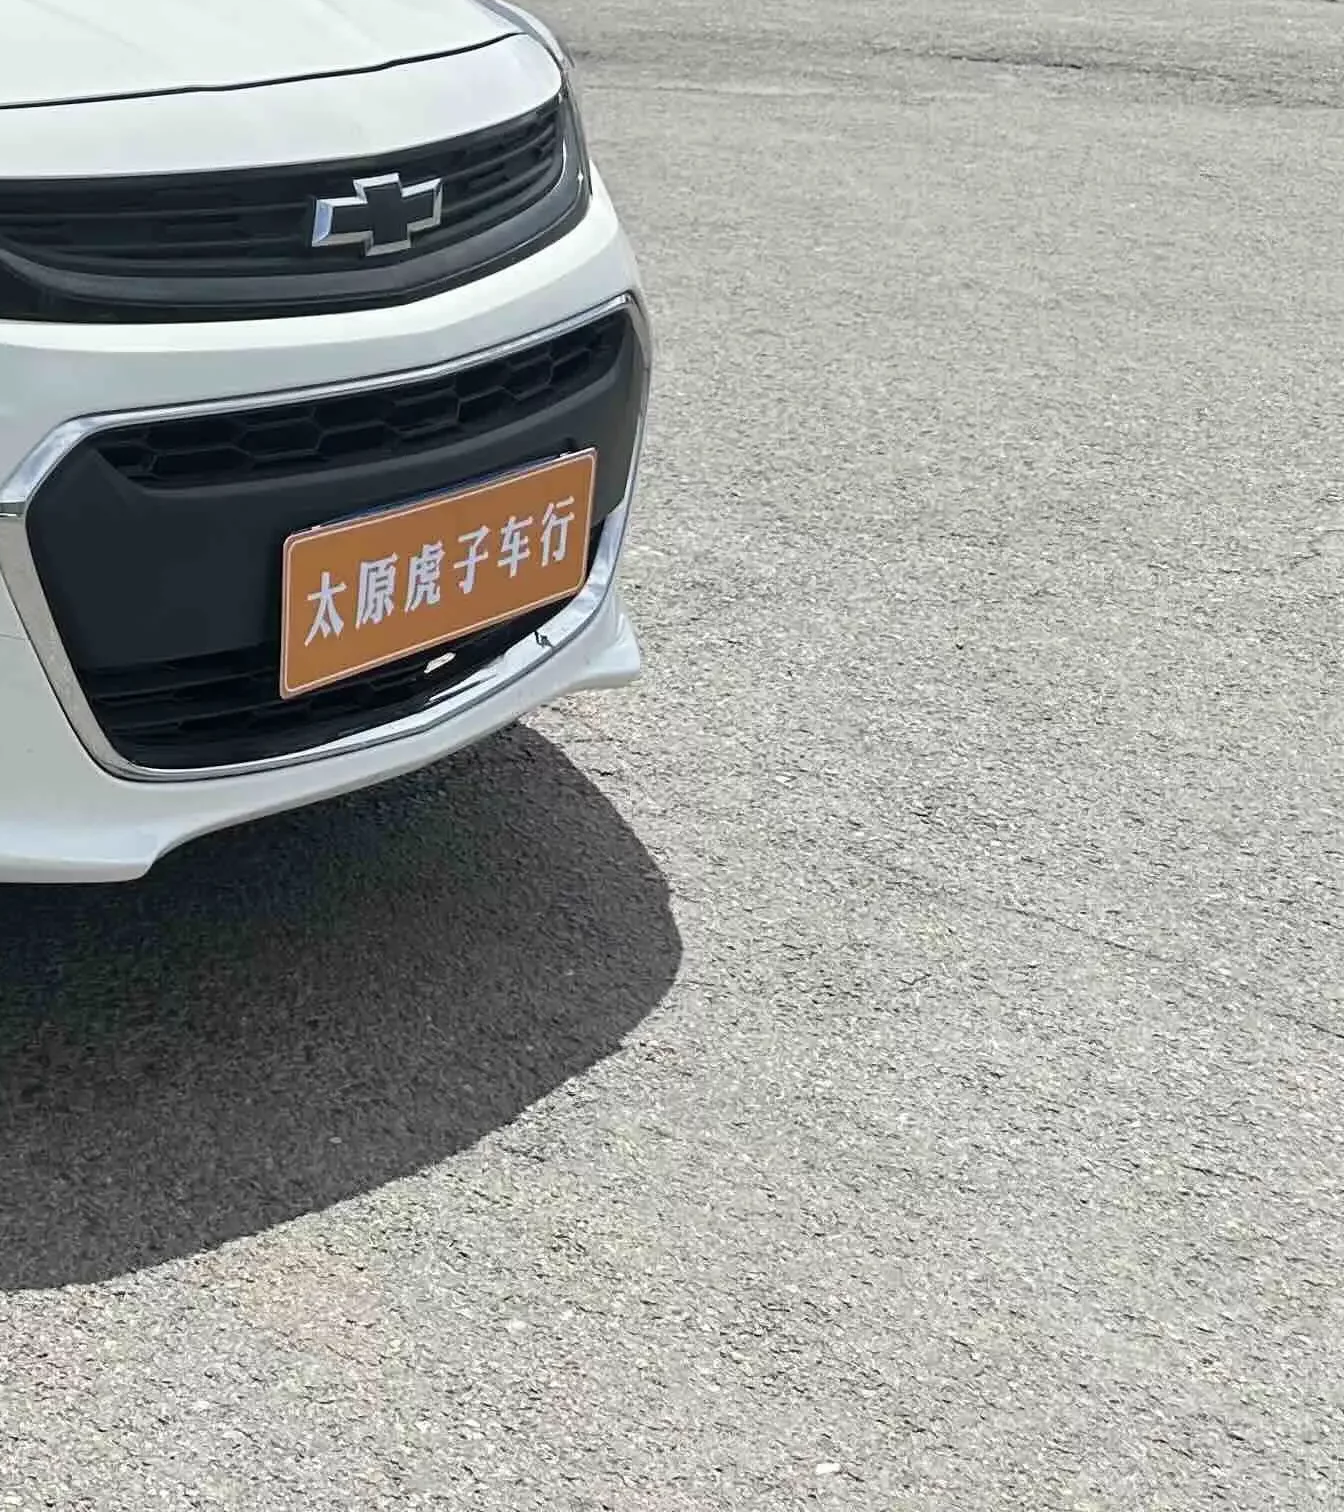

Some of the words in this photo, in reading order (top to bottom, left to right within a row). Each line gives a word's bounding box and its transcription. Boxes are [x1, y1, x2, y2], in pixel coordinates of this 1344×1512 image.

[304, 496, 575, 646] 太原虎子车行
